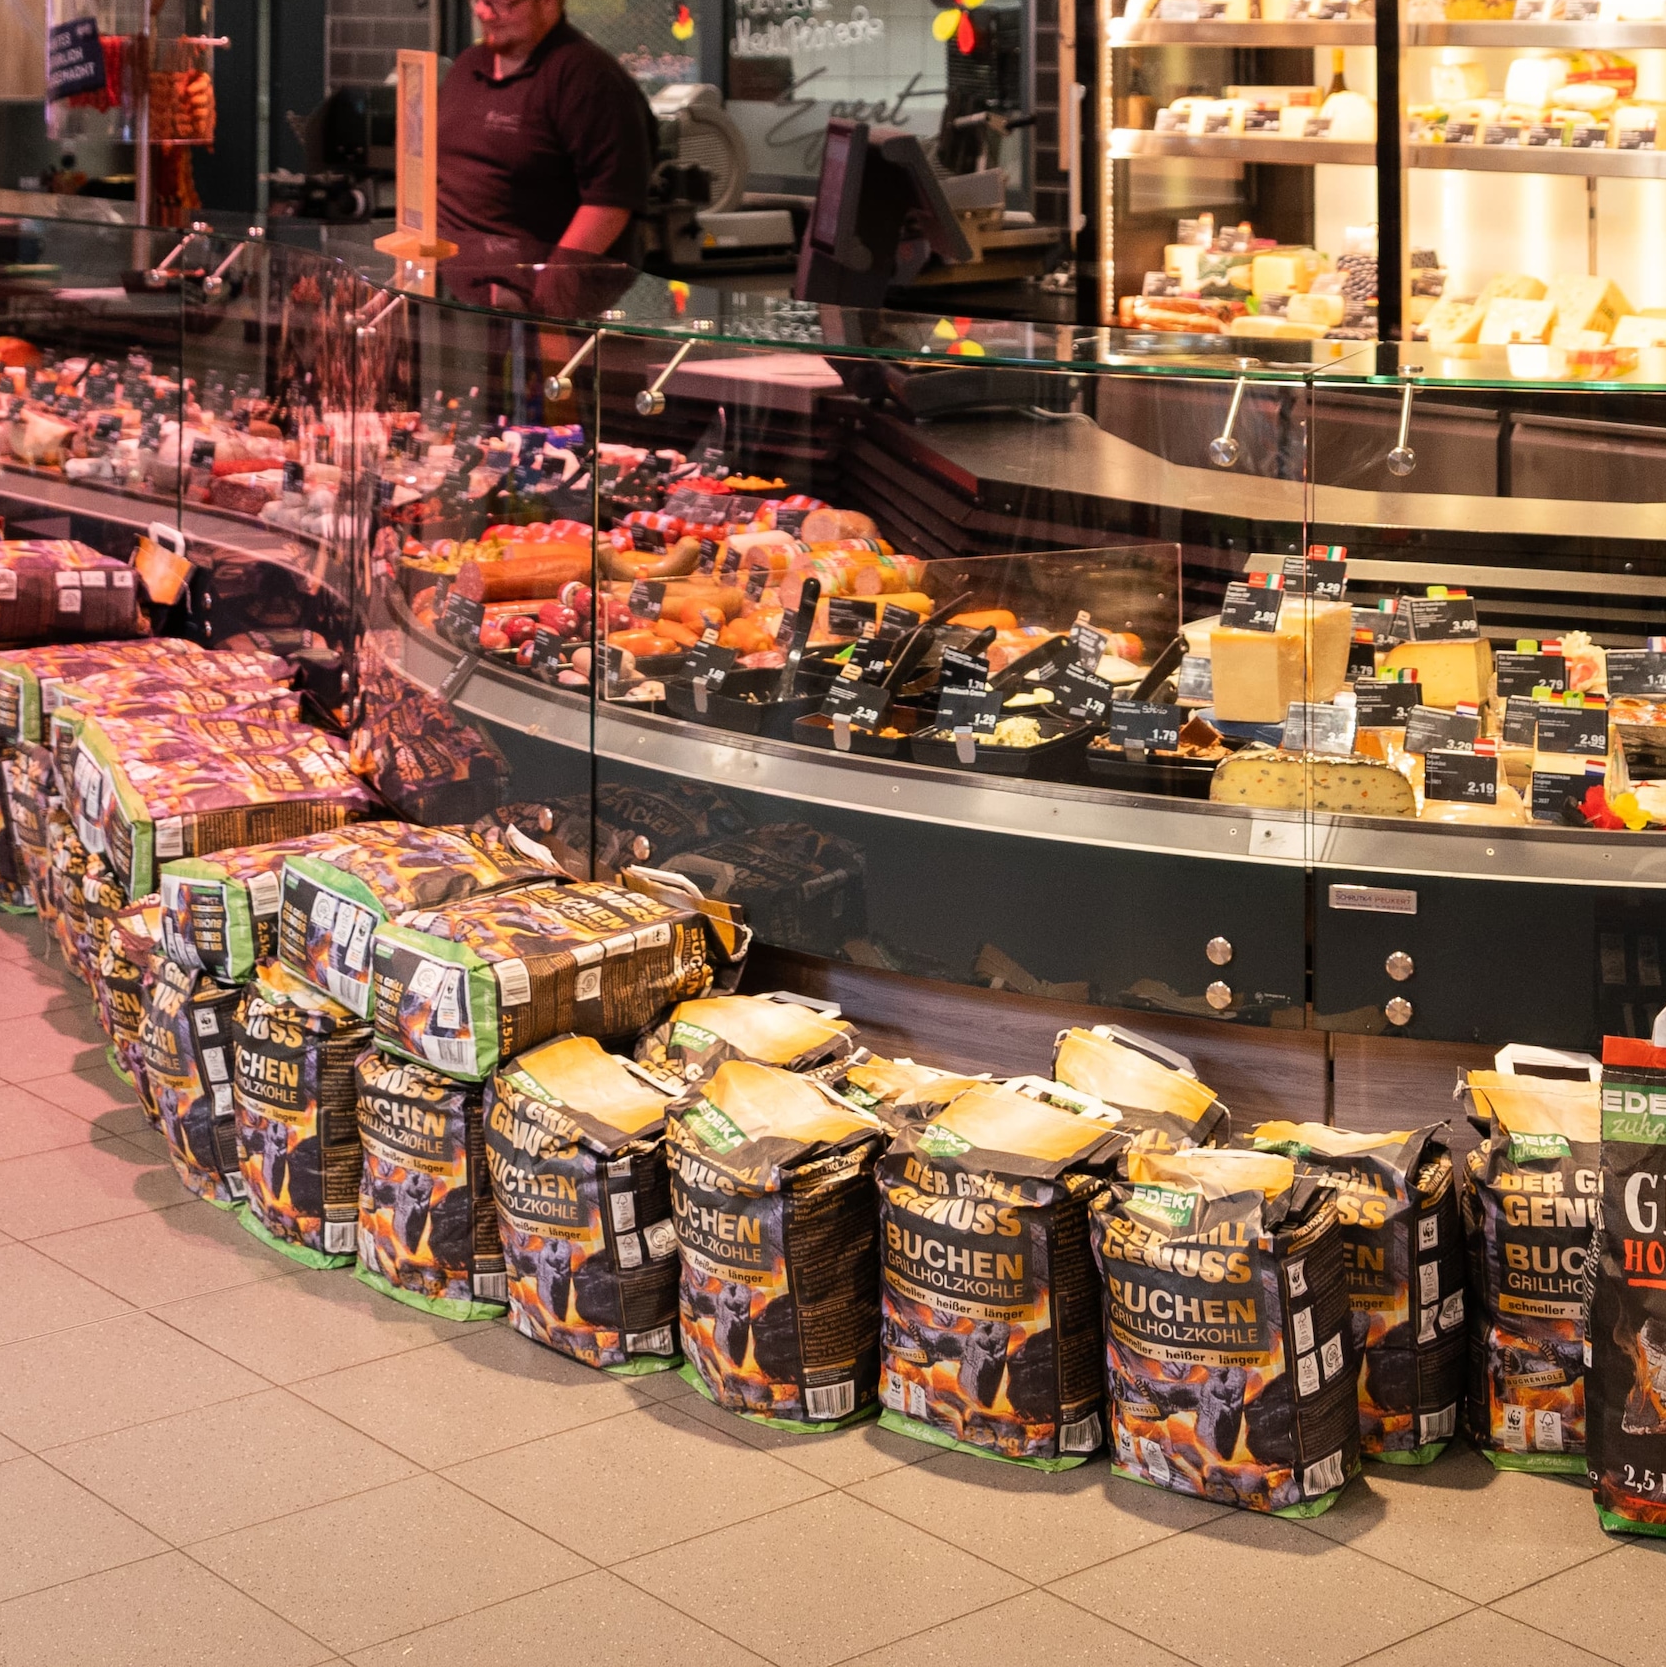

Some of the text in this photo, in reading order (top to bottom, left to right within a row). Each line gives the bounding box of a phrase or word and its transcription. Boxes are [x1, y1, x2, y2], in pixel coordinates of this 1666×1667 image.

[1316, 581, 1341, 594] 3.29
[1452, 620, 1477, 631] 3.09
[854, 705, 879, 721] 2.39
[1084, 696, 1106, 712] 1.79
[973, 712, 997, 726] 1.29
[1151, 727, 1178, 742] 1.79
[1579, 733, 1606, 745] 2.99
[1467, 781, 1495, 794] 2.19
[696, 1099, 748, 1148] EDEKA
[413, 1158, 444, 1173] länger
[902, 1158, 950, 1197] DER
[1500, 1171, 1564, 1194] DER
[1133, 1185, 1195, 1211] EDEKA
[887, 1184, 1023, 1238] GENUSS
[548, 1225, 582, 1239] länger
[885, 1220, 1024, 1280] BUCHEN
[1102, 1231, 1253, 1283] GENUSS
[694, 1255, 764, 1284] heißer länger
[887, 1247, 1024, 1299] GRILLHOLZKOHLE
[936, 1297, 972, 1314] heißer
[983, 1306, 1024, 1321] länger
[1108, 1274, 1257, 1325] BUCHEN
[1508, 1300, 1566, 1316] schneller
[1110, 1302, 1259, 1344] GRILLHOLZKOHLE
[1165, 1349, 1206, 1362] heißer
[1218, 1354, 1261, 1368] länger
[1623, 1462, 1656, 1494] 2,5
